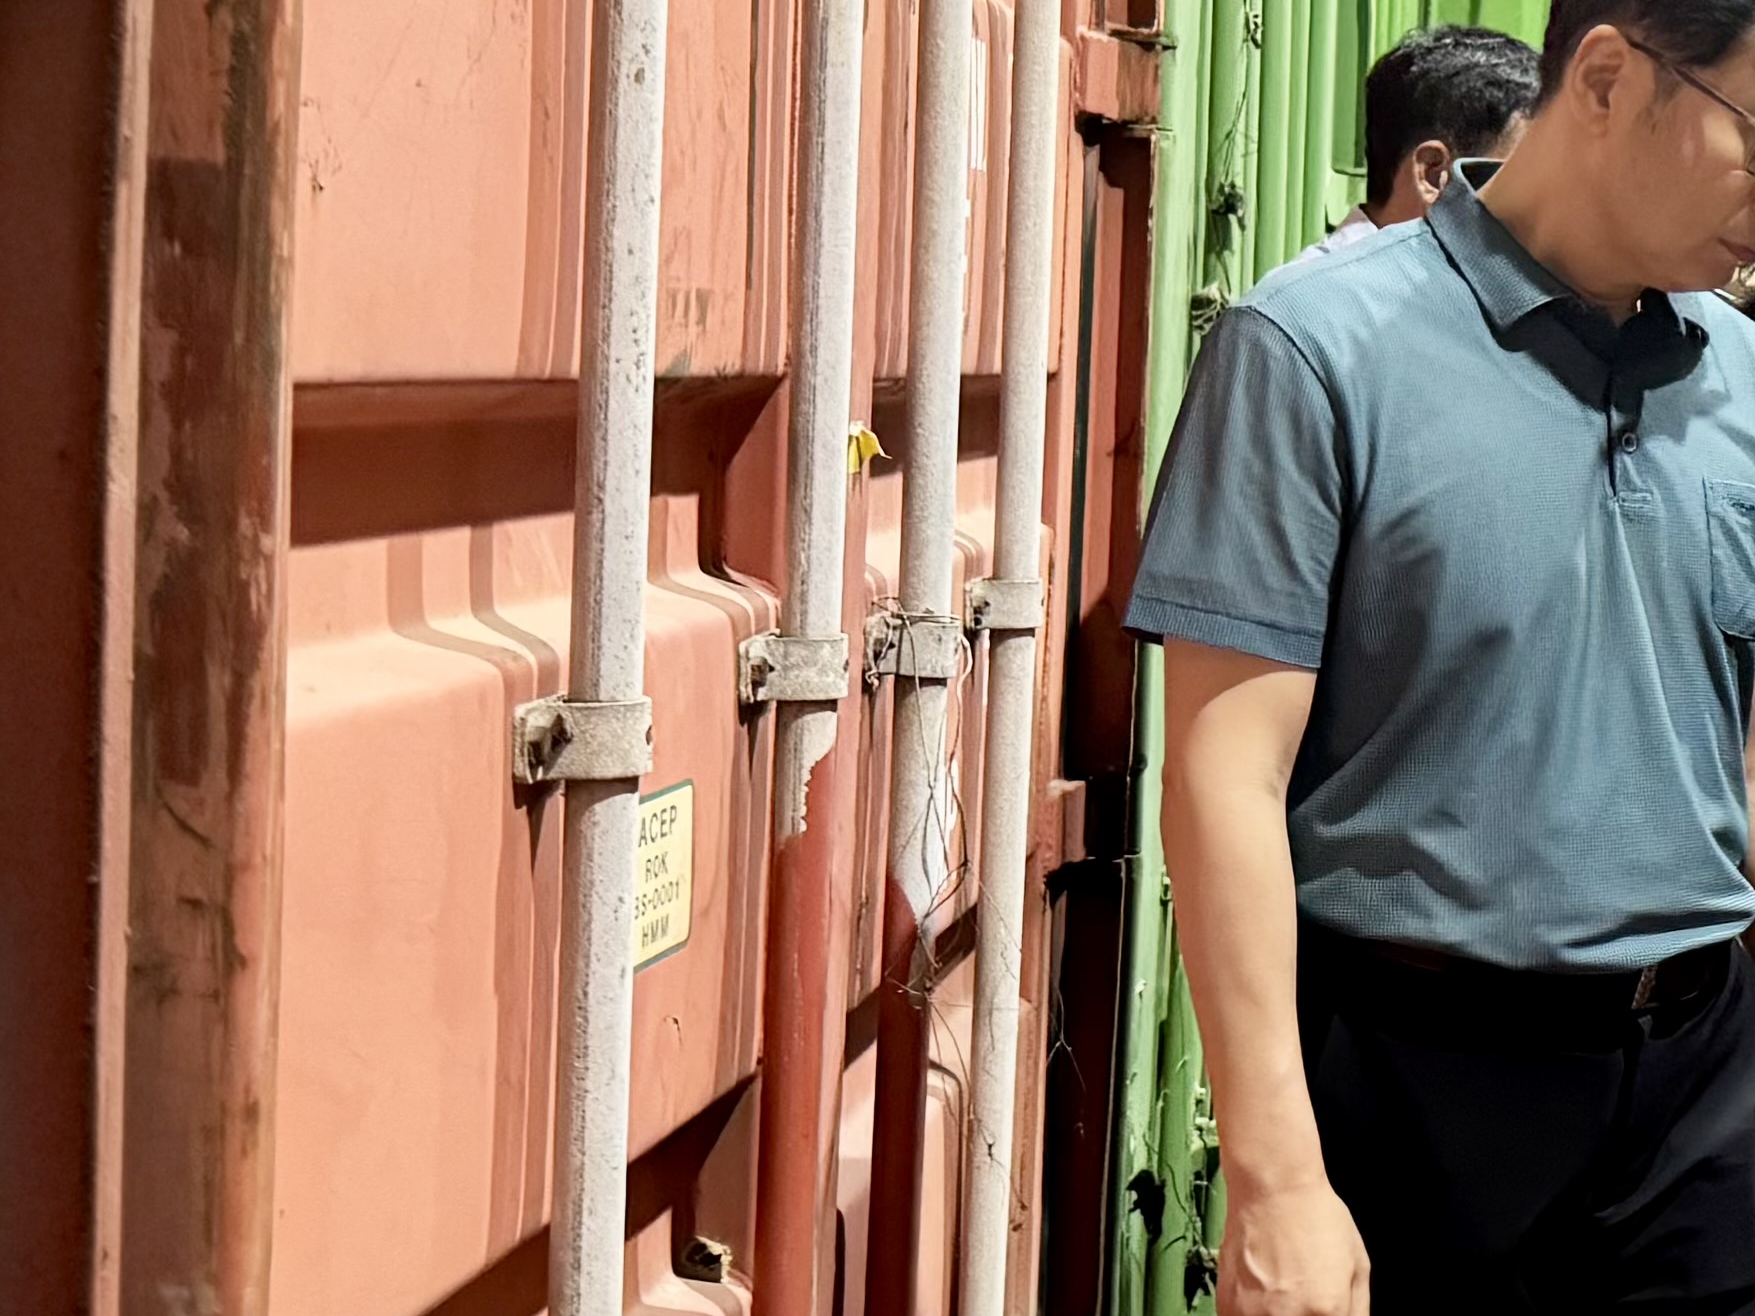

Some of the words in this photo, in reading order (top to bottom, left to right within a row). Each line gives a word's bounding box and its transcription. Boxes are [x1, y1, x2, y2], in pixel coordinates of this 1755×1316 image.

[638, 804, 677, 848] ACEP
[645, 851, 669, 884] ROK
[642, 914, 670, 950] HMM
